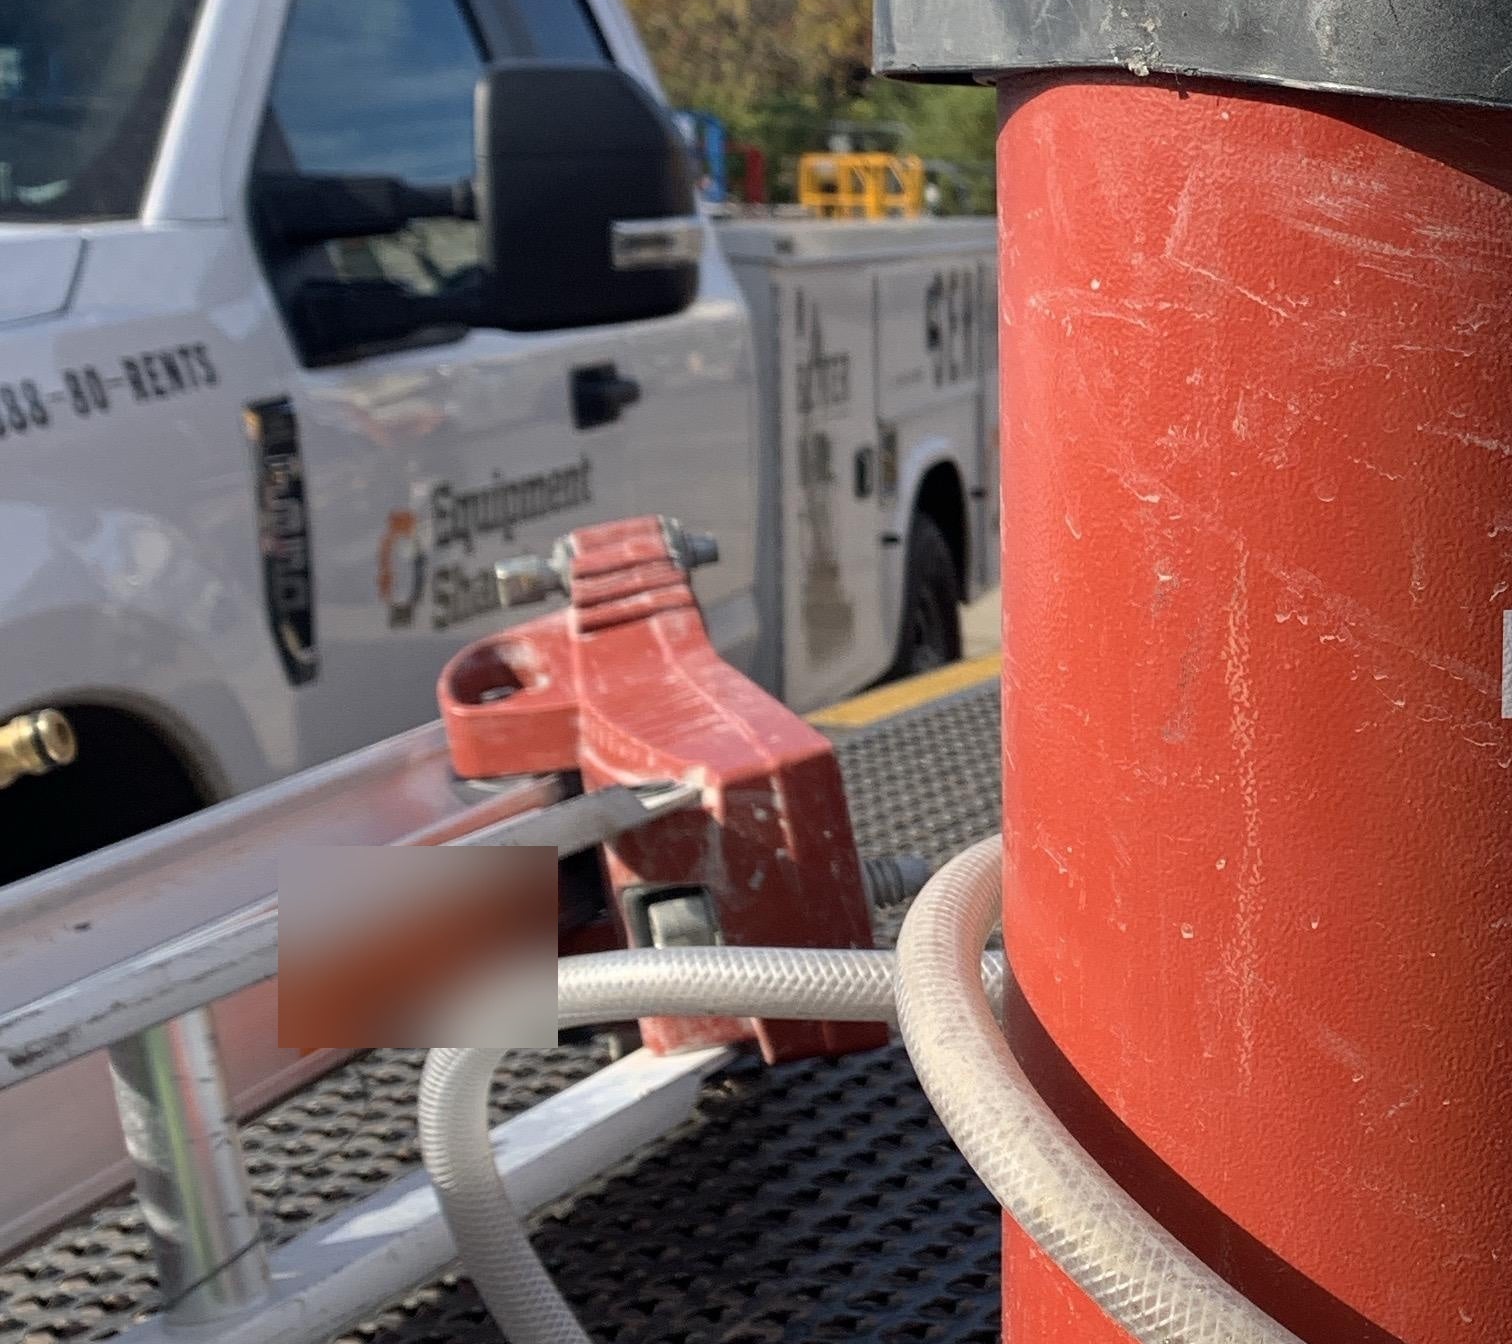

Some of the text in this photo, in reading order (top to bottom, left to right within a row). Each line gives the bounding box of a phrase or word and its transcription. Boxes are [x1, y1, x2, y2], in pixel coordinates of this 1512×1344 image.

[0, 343, 216, 438] 88-80-RENTS
[432, 452, 591, 552] Equipment
[432, 560, 500, 631] Sha
